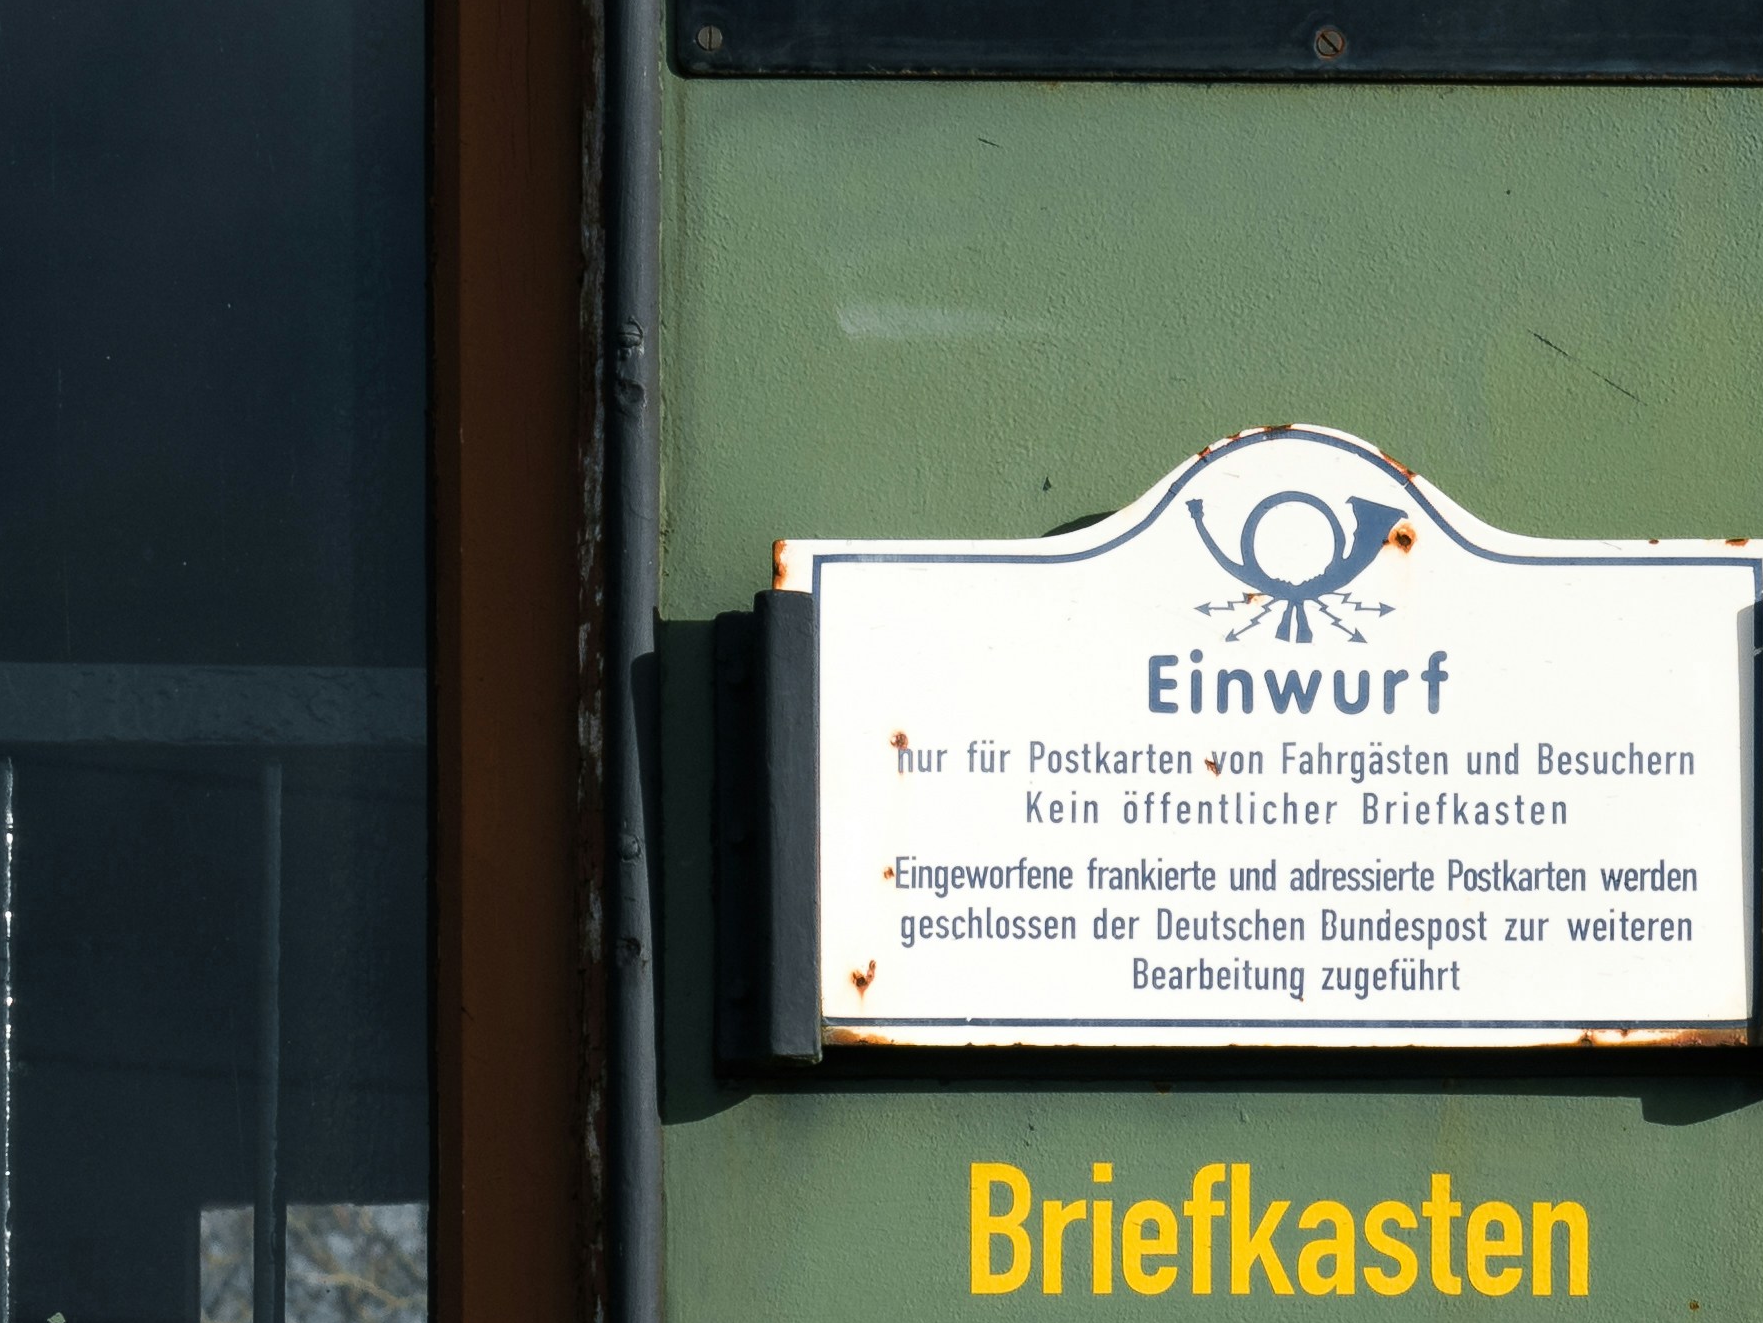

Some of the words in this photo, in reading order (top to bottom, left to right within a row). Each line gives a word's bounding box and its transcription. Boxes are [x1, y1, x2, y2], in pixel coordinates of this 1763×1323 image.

[1149, 649, 1449, 715] Einwurf
[897, 747, 947, 772] nur
[967, 740, 1011, 773] für
[1030, 742, 1192, 774] Postkarten
[1209, 750, 1263, 774] von
[1283, 741, 1448, 784] Fahrgästen
[1467, 743, 1518, 775] und
[1538, 742, 1694, 775] Besuchern
[1027, 791, 1098, 823] Kein
[1124, 790, 1337, 825] öffentlicher
[1363, 792, 1566, 825] Briefkasten
[896, 857, 1073, 898] Eingeworfene
[1087, 858, 1215, 891] frankierte
[1230, 859, 1276, 891] und
[1290, 859, 1434, 891] adressierte
[1448, 859, 1586, 892] Postkarten
[1601, 859, 1697, 892] werden
[901, 907, 1075, 948] geschlossen
[1094, 908, 1139, 940] der
[1157, 908, 1304, 941] Deutschen
[1322, 909, 1486, 950] Bundespost
[1505, 918, 1548, 941] zur
[1567, 909, 1691, 941] weiteren
[1134, 958, 1304, 999] Bearbeitung
[1322, 958, 1458, 1000] zugeführt
[971, 1163, 1588, 1296] Briefkasten
